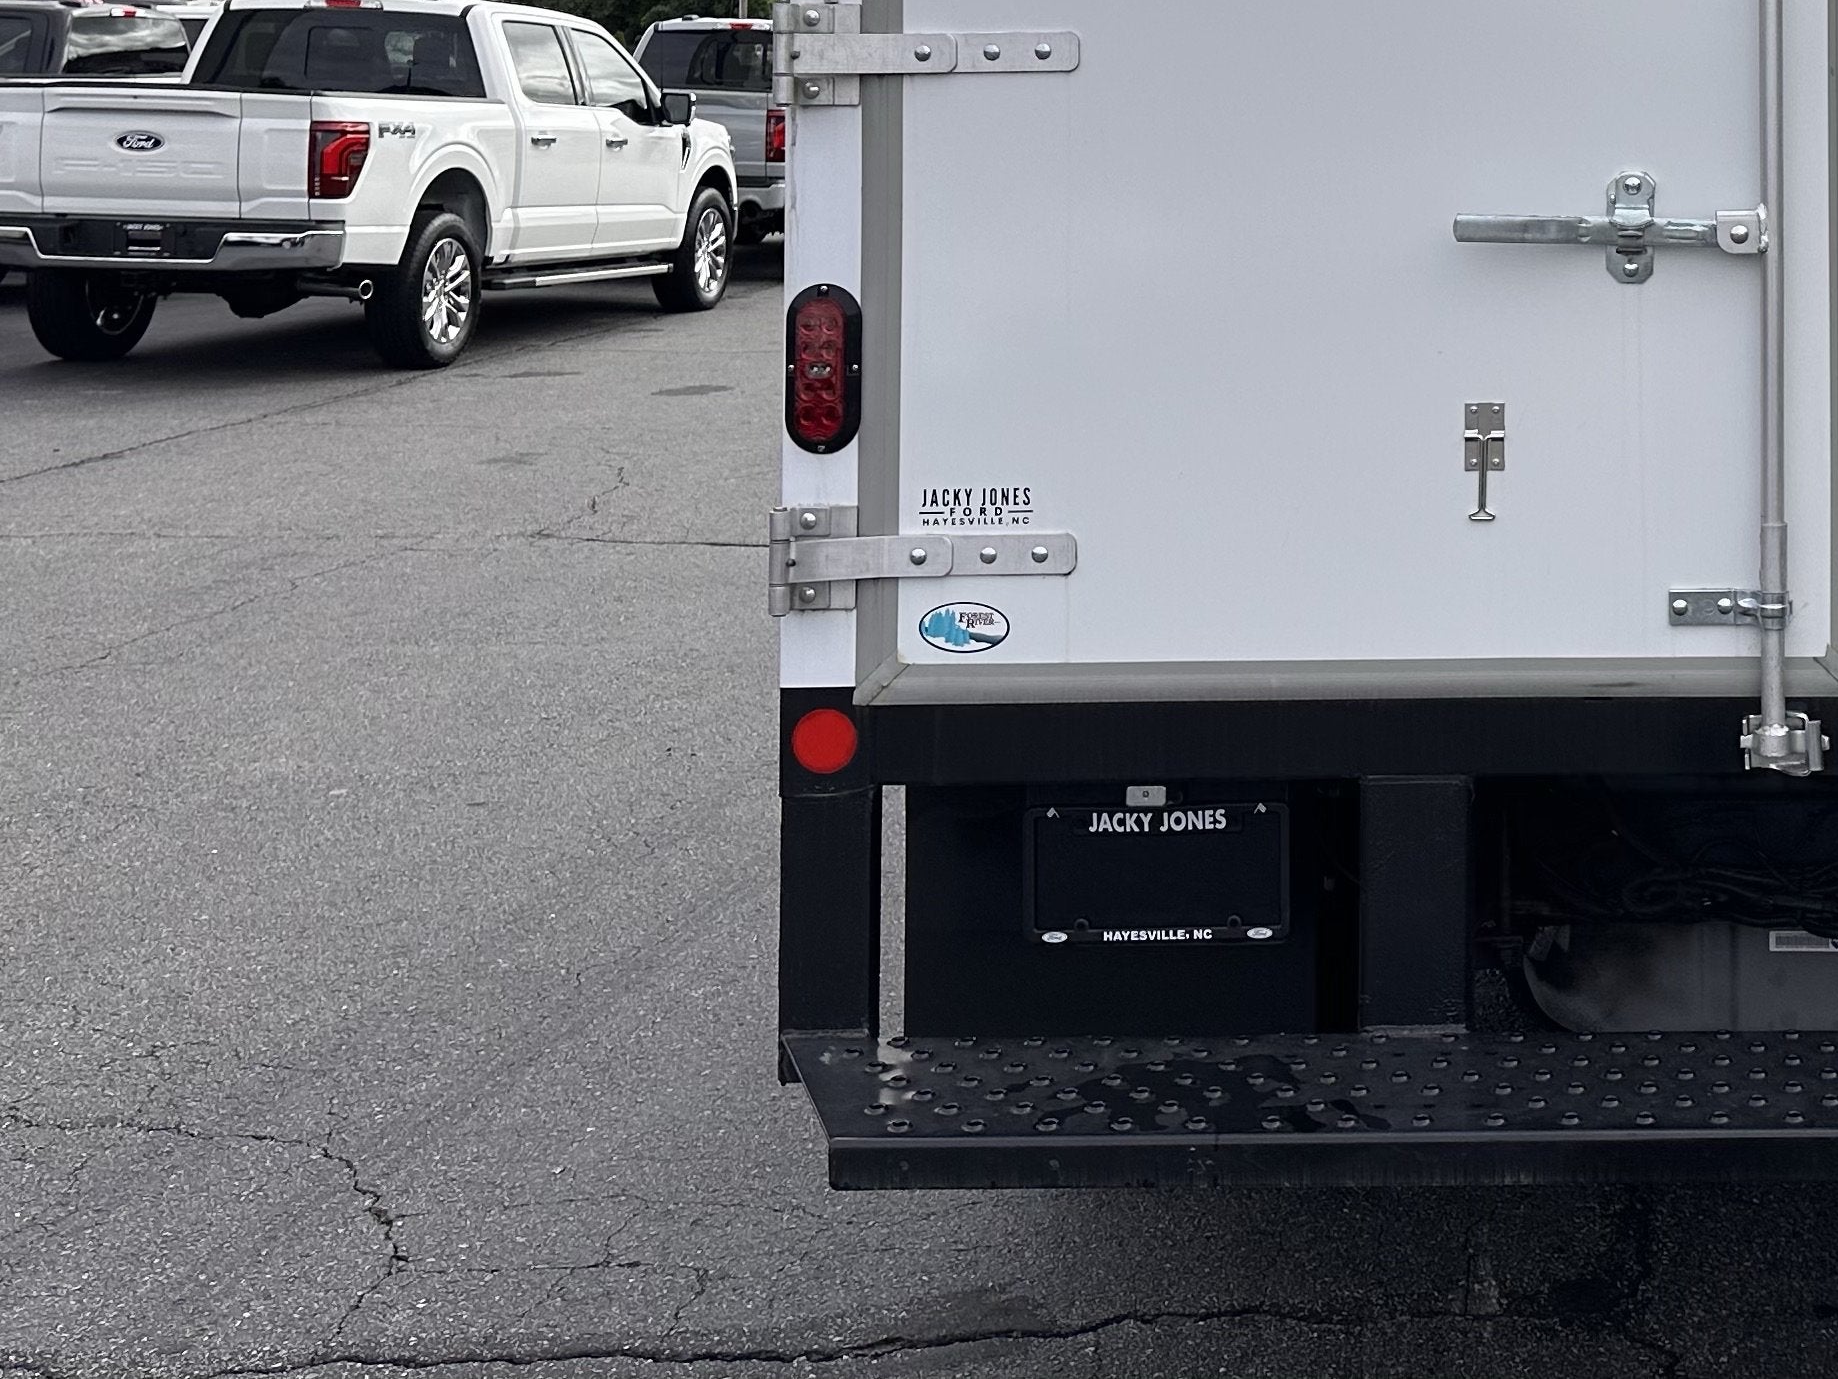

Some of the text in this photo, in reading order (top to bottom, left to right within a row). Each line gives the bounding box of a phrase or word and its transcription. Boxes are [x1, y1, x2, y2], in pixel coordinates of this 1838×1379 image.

[921, 487, 1031, 508] JACKY JONES
[949, 506, 1003, 517] FORD
[1011, 516, 1030, 525] NC
[1088, 808, 1227, 833] JACKY JONES
[1103, 929, 1213, 941] HAYESVILLE, NC
